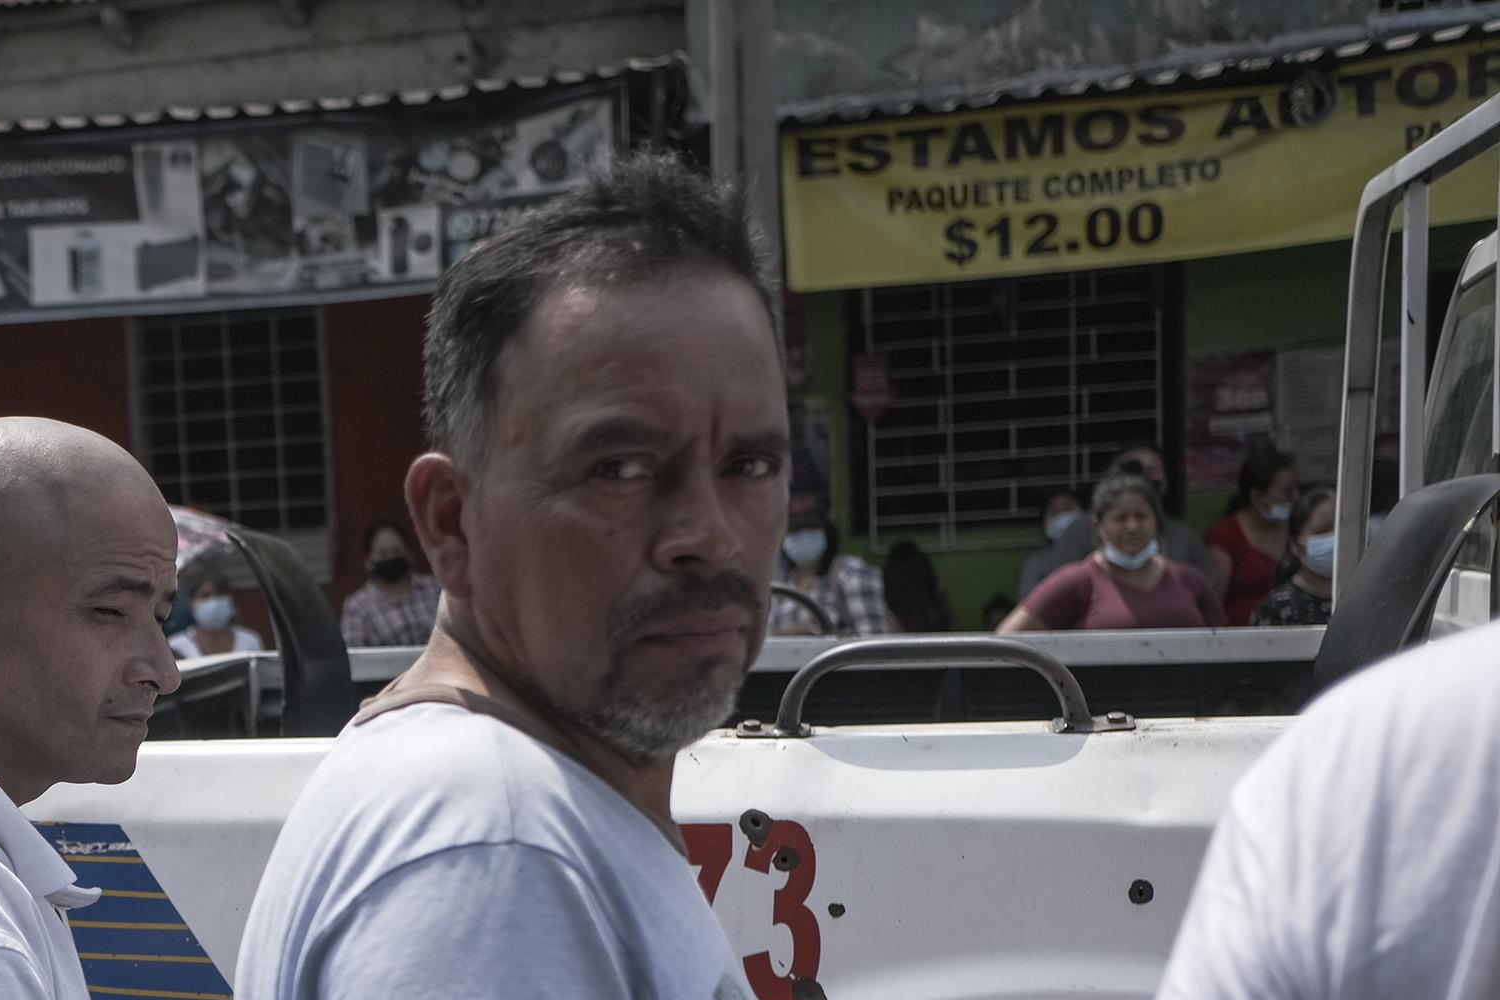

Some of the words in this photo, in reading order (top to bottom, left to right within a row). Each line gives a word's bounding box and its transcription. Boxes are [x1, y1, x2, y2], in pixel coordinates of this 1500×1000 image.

[796, 103, 1188, 180] ESTAMOS
[887, 177, 1032, 216] PAQUETE
[1043, 156, 1223, 200] COMPLETO
[944, 201, 1164, 267] $12.00
